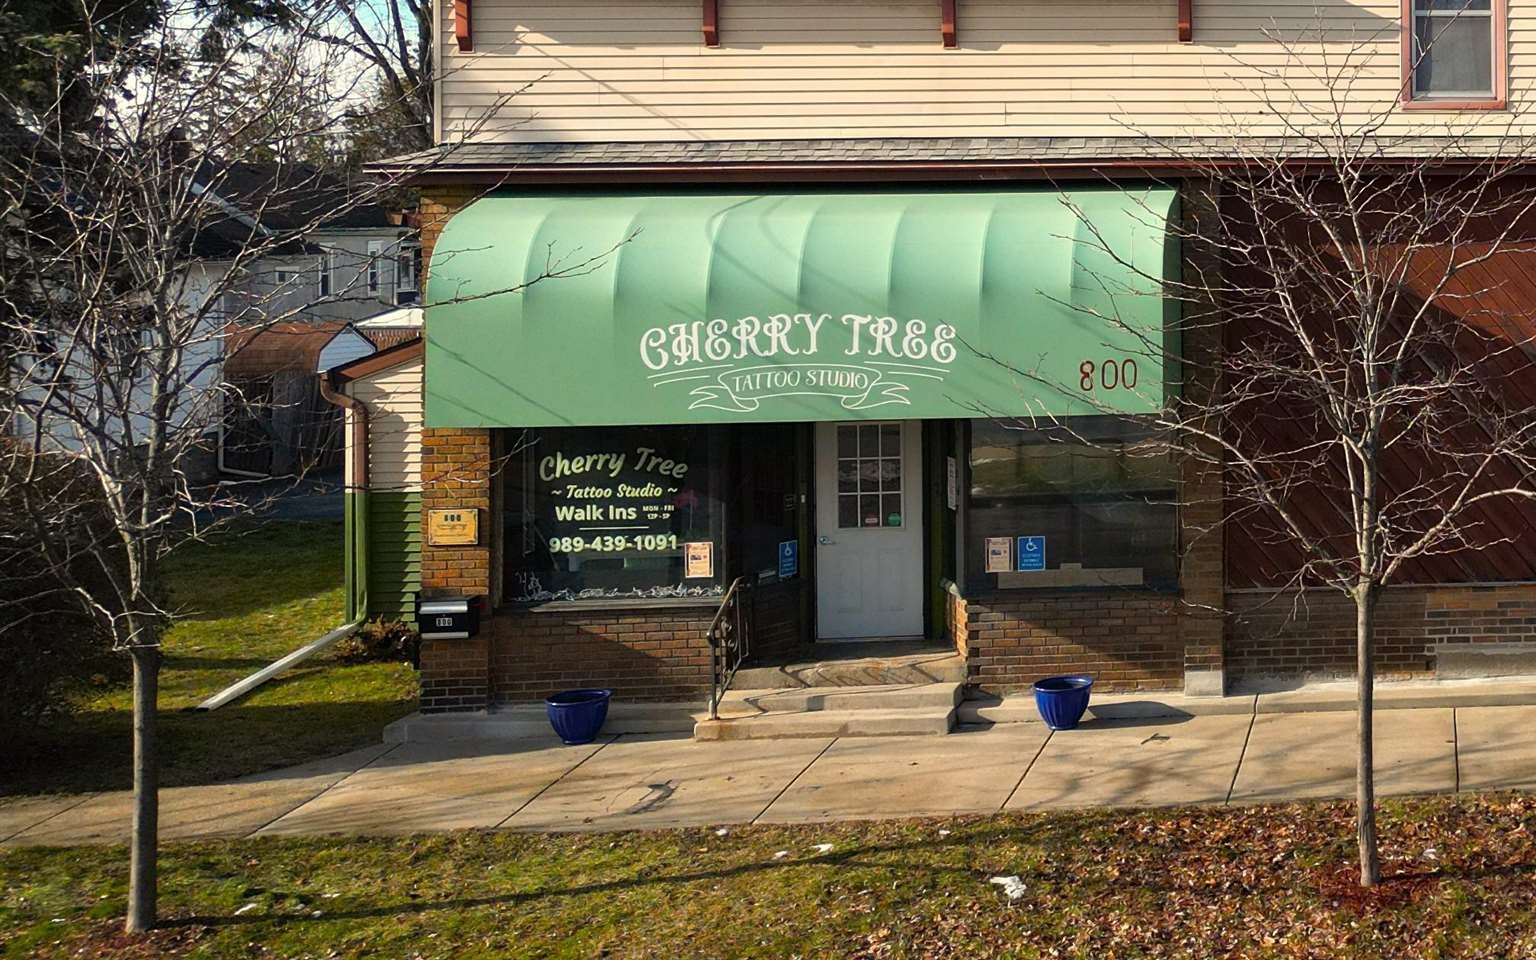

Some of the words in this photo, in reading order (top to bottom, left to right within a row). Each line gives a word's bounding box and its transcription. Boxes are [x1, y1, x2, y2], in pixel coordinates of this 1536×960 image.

[640, 313, 832, 370] CHERRY
[842, 314, 956, 363] TREE
[732, 370, 800, 392] TATTOO
[806, 369, 868, 389] STUDIO
[1080, 358, 1137, 391] 800
[539, 451, 626, 481] Cherry
[634, 447, 688, 478] Tree
[566, 484, 612, 499] Tattoo
[617, 482, 663, 498] Studio
[555, 505, 604, 521] Walk
[609, 505, 637, 520] Ins
[550, 535, 677, 553] 989-439-1091
